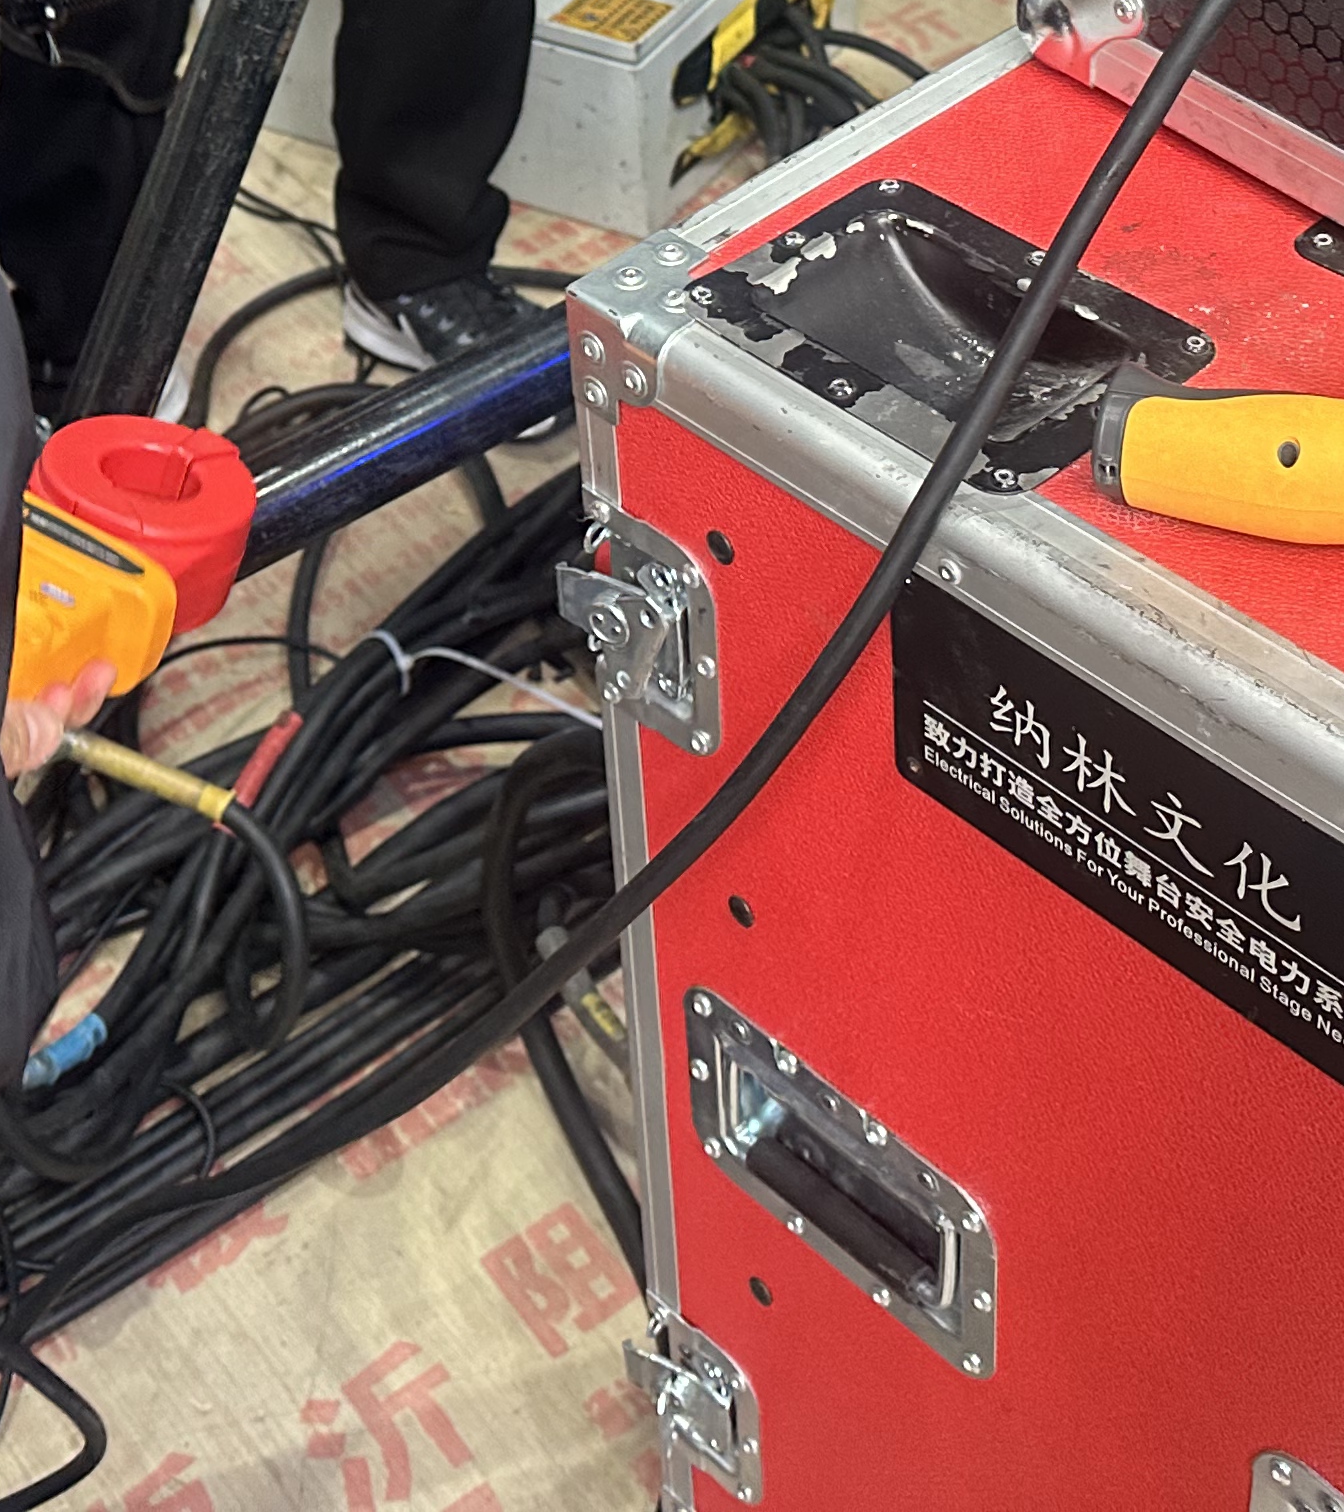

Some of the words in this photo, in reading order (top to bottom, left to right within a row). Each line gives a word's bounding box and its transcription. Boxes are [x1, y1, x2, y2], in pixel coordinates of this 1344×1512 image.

[923, 744, 996, 805] Electrical
[998, 795, 1073, 857] Solutions
[1076, 847, 1105, 878] For
[1107, 867, 1145, 906] Your
[1147, 896, 1256, 984] Professional
[1259, 974, 1313, 1023] Stage
[989, 684, 1302, 932] 纳林文化
